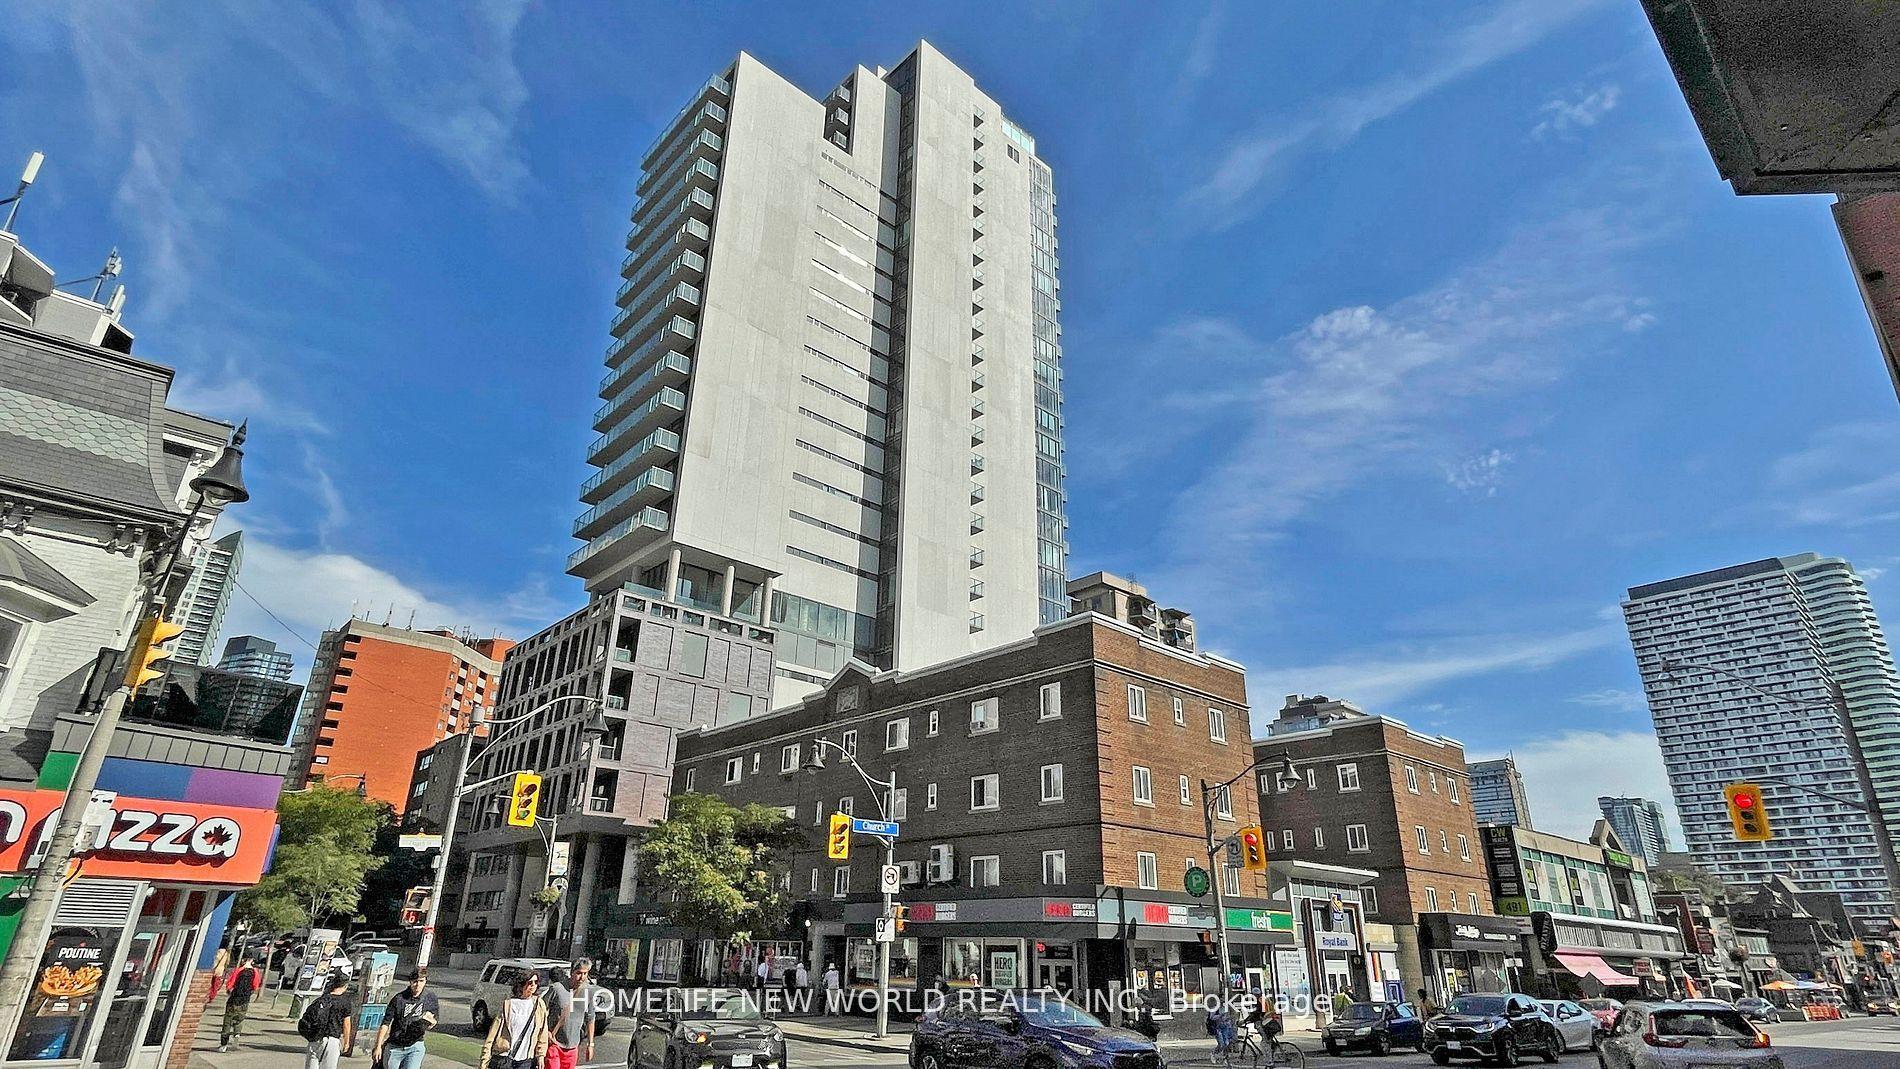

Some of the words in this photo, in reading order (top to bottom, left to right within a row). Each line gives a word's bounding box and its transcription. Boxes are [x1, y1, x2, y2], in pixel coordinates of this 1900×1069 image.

[863, 820, 885, 832] Church
[1322, 936, 1336, 948] Royal
[1337, 937, 1348, 946] Bank
[58, 947, 102, 960] POUTINE
[994, 957, 1013, 970] HERO
